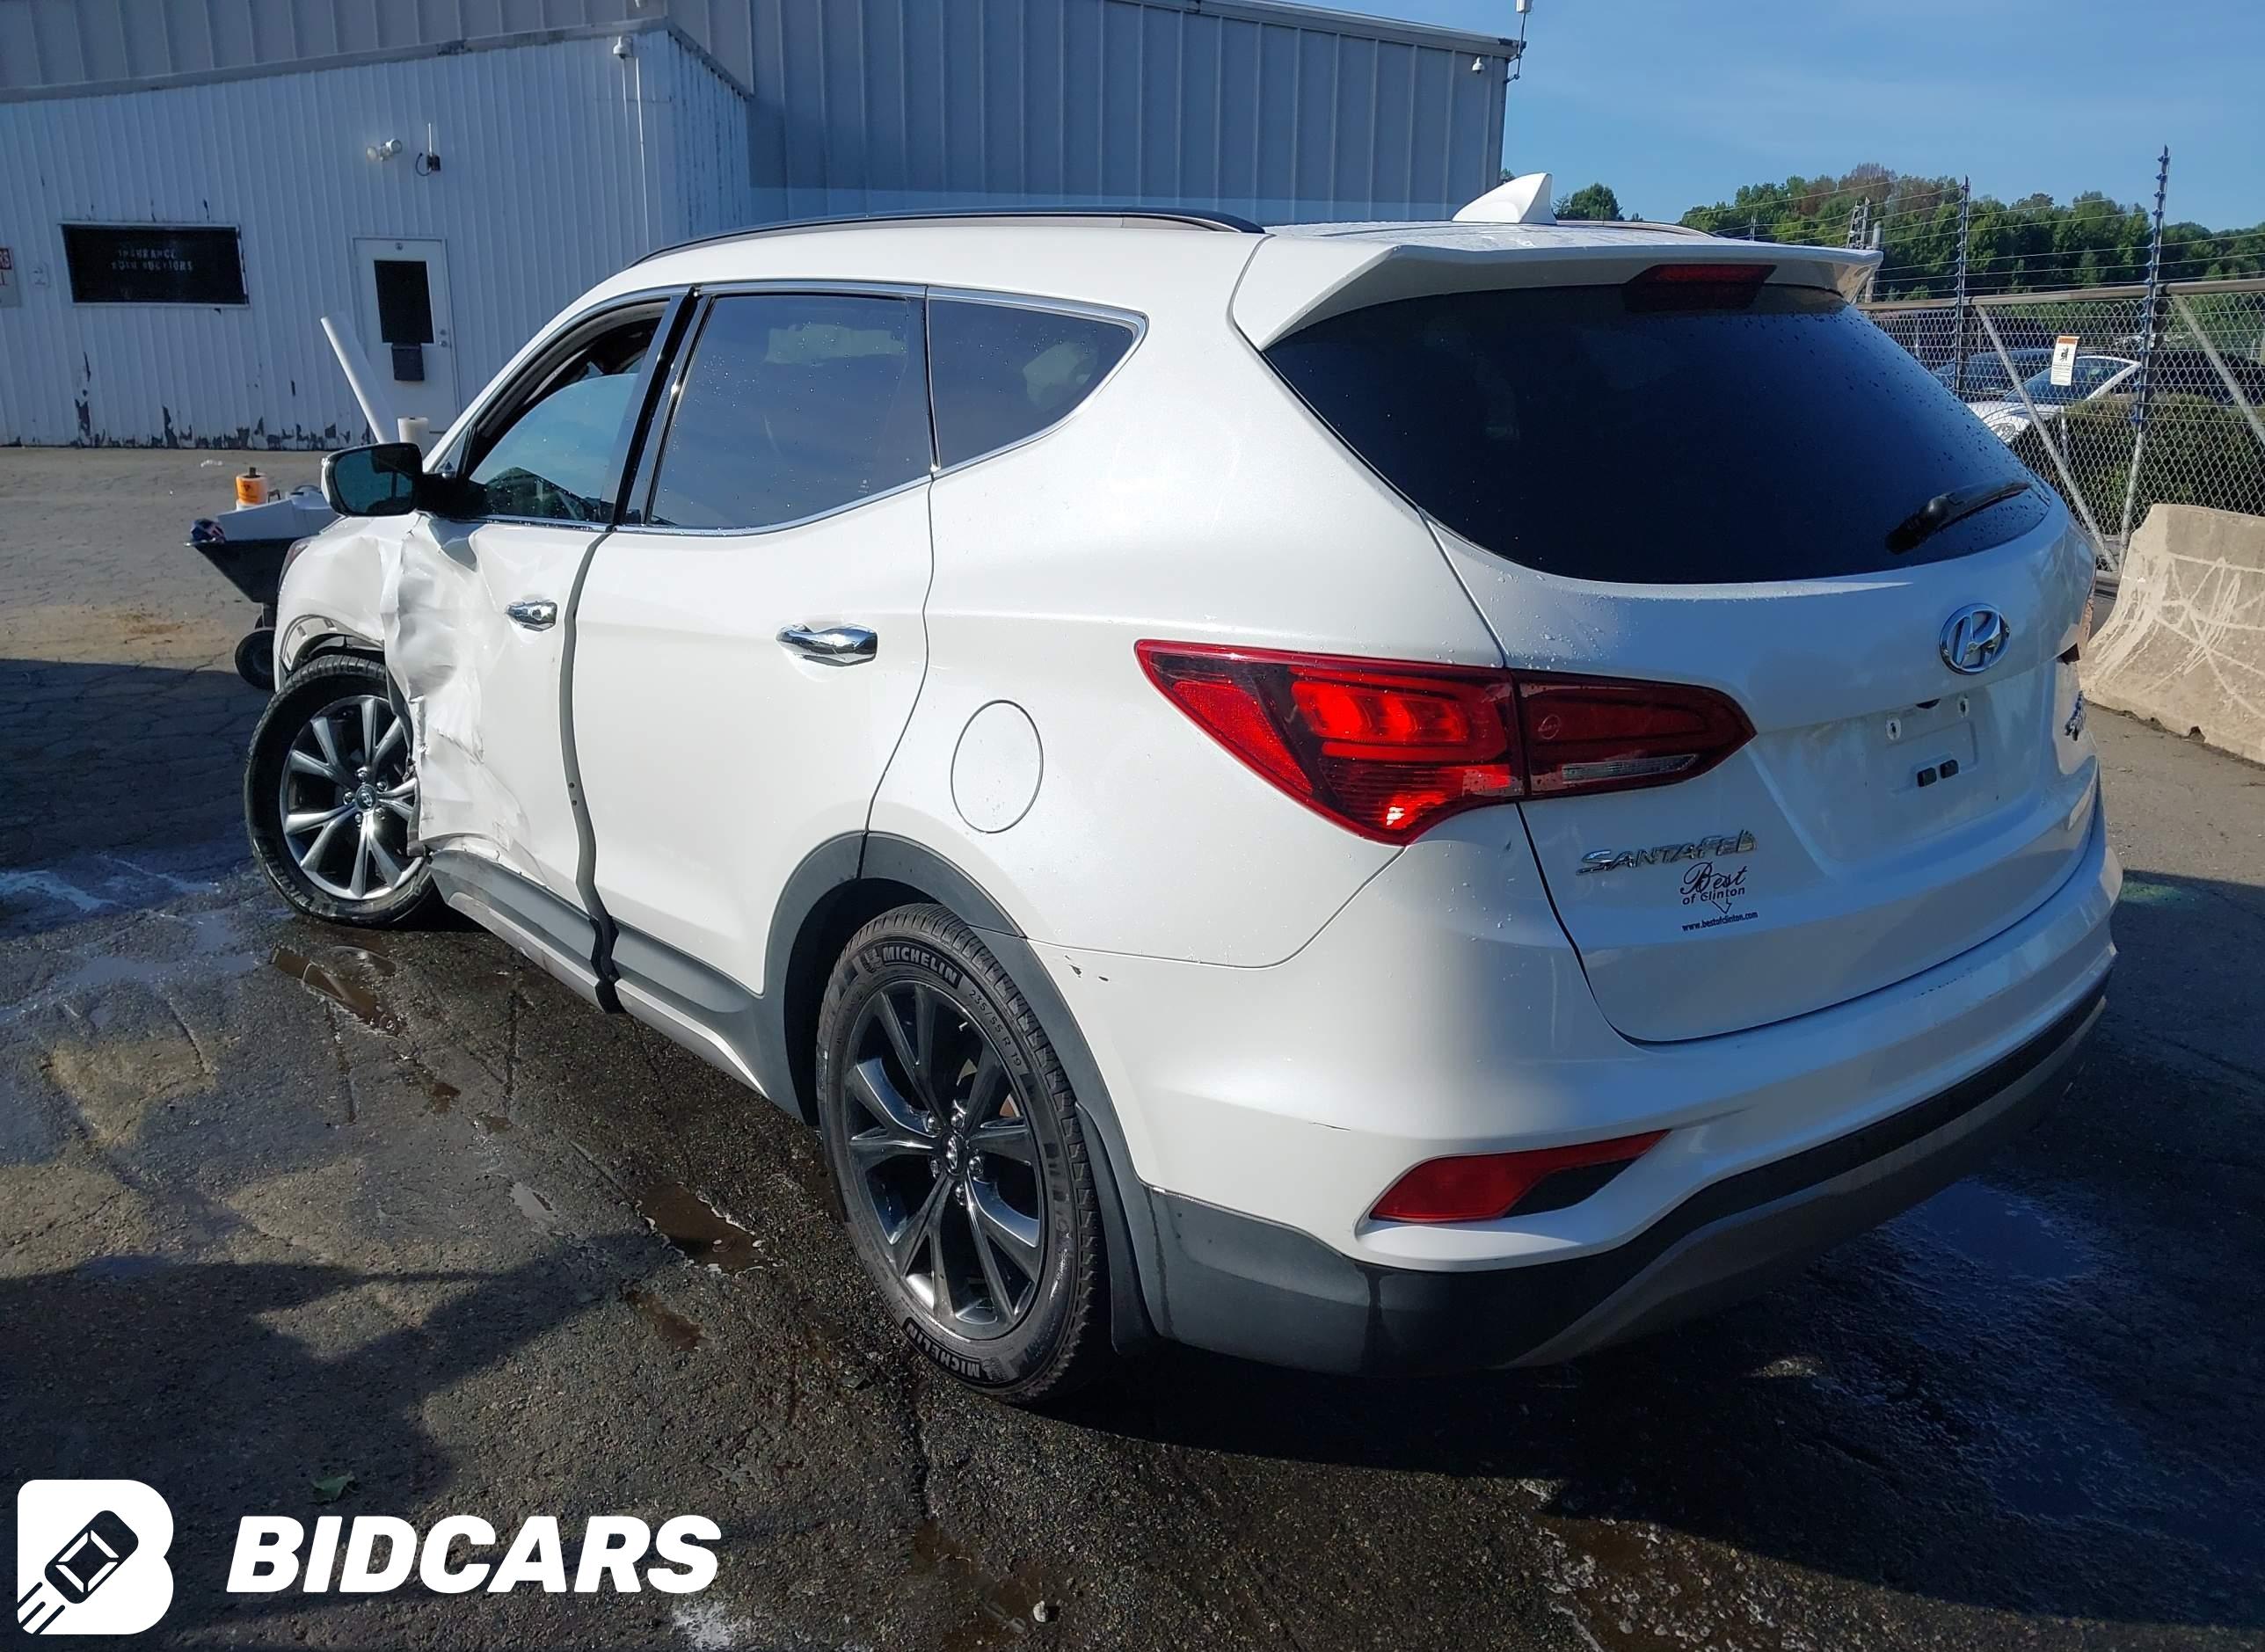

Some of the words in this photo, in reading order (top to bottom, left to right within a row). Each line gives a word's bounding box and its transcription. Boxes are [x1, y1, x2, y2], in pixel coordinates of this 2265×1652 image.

[1679, 861, 1748, 894] Best
[1682, 892, 1696, 906] of
[1701, 887, 1745, 902] Clinton
[1681, 911, 1759, 932] www.bestofclinton.com
[883, 946, 958, 986] MICHELIN
[969, 989, 1003, 1033] 235/55
[1002, 1036, 1011, 1046] R
[1011, 1052, 1022, 1066] 19
[906, 1321, 981, 1379] MICHELIN
